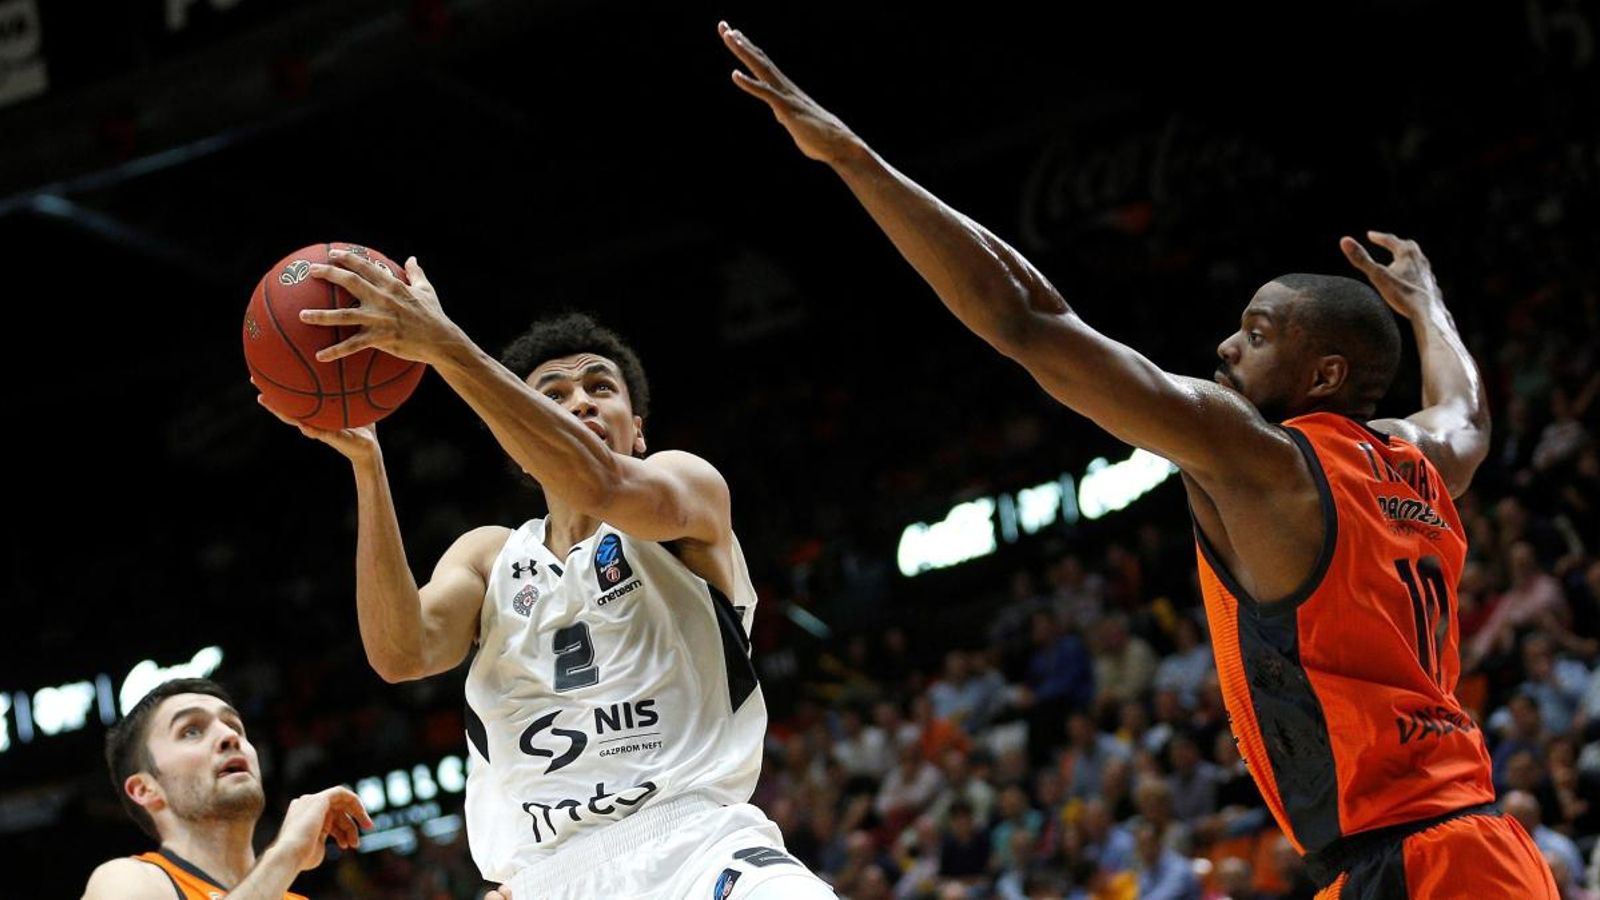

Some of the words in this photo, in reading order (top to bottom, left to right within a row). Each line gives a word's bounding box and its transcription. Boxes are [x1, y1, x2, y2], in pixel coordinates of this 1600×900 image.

[597, 580, 642, 606] oneteam
[552, 620, 600, 693] 2
[594, 699, 659, 734] NIS
[599, 744, 641, 757] GAZPROM
[641, 740, 663, 750] NEFT
